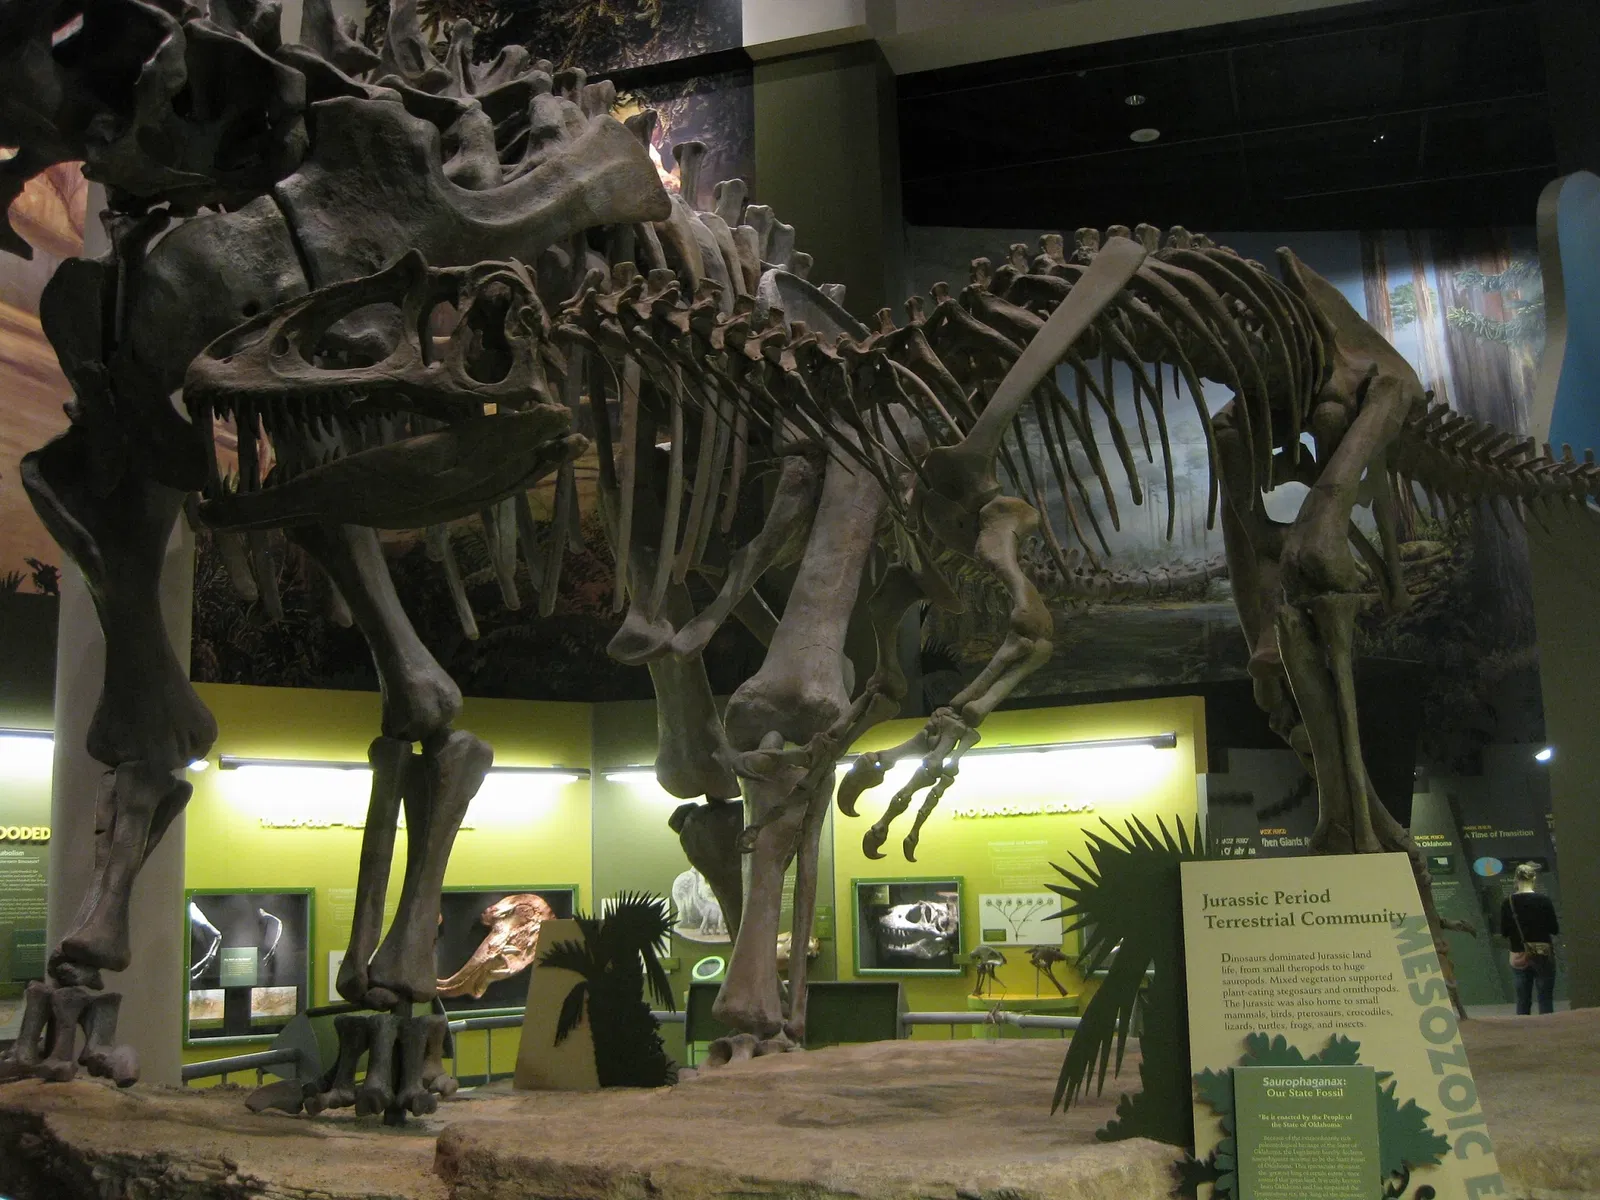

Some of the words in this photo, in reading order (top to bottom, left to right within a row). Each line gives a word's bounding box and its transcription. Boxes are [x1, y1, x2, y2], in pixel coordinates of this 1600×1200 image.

[1471, 831, 1488, 839] Time
[1499, 829, 1534, 838] Transition
[1280, 837, 1302, 847] Giants
[1422, 840, 1452, 848] Oklahoma
[1202, 891, 1269, 911] Jurassic
[1274, 889, 1331, 905] Period
[1204, 912, 1296, 929] Terrestrial
[1300, 908, 1407, 926] Community
[1221, 953, 1267, 963] Dinosaurs
[1268, 952, 1315, 962] dominated
[1317, 951, 1351, 962] Jurassic
[1352, 950, 1372, 959] land
[1222, 965, 1238, 975] life,
[1240, 964, 1260, 974] from
[1262, 964, 1285, 973] small
[1287, 963, 1330, 974] theropods
[1332, 964, 1342, 972] to
[1343, 963, 1365, 974] huge
[1222, 977, 1267, 988] sauropods.
[1270, 976, 1298, 984] Mixed
[1300, 975, 1346, 986] vegetation
[1348, 973, 1393, 984] supported
[1222, 987, 1275, 999] plant-eating
[1277, 987, 1322, 997] stegosaurs
[1324, 986, 1340, 994] and
[1342, 985, 1399, 995] ornithopods.
[1224, 1000, 1241, 1008] The
[1242, 999, 1277, 1009] Jurassic
[1298, 997, 1314, 1006] also
[1316, 998, 1342, 1006] home
[1355, 996, 1379, 1005] small
[1224, 1010, 1269, 1020] mammals,
[1270, 1009, 1295, 1019] birds,
[1297, 1010, 1344, 1020] pterosaurs,
[1346, 1008, 1393, 1018] crocodiles,
[1224, 1021, 1255, 1031] lizards,
[1257, 1021, 1287, 1031] turtles,
[1290, 1020, 1315, 1031] frogs,
[1316, 1020, 1333, 1028] and
[1335, 1019, 1367, 1028] insects.
[1263, 1077, 1347, 1088] Saurophaganax:
[1267, 1089, 1286, 1097] Our
[1288, 1088, 1313, 1097] State
[1316, 1088, 1344, 1097] Fossil
[1302, 1114, 1310, 1122] by
